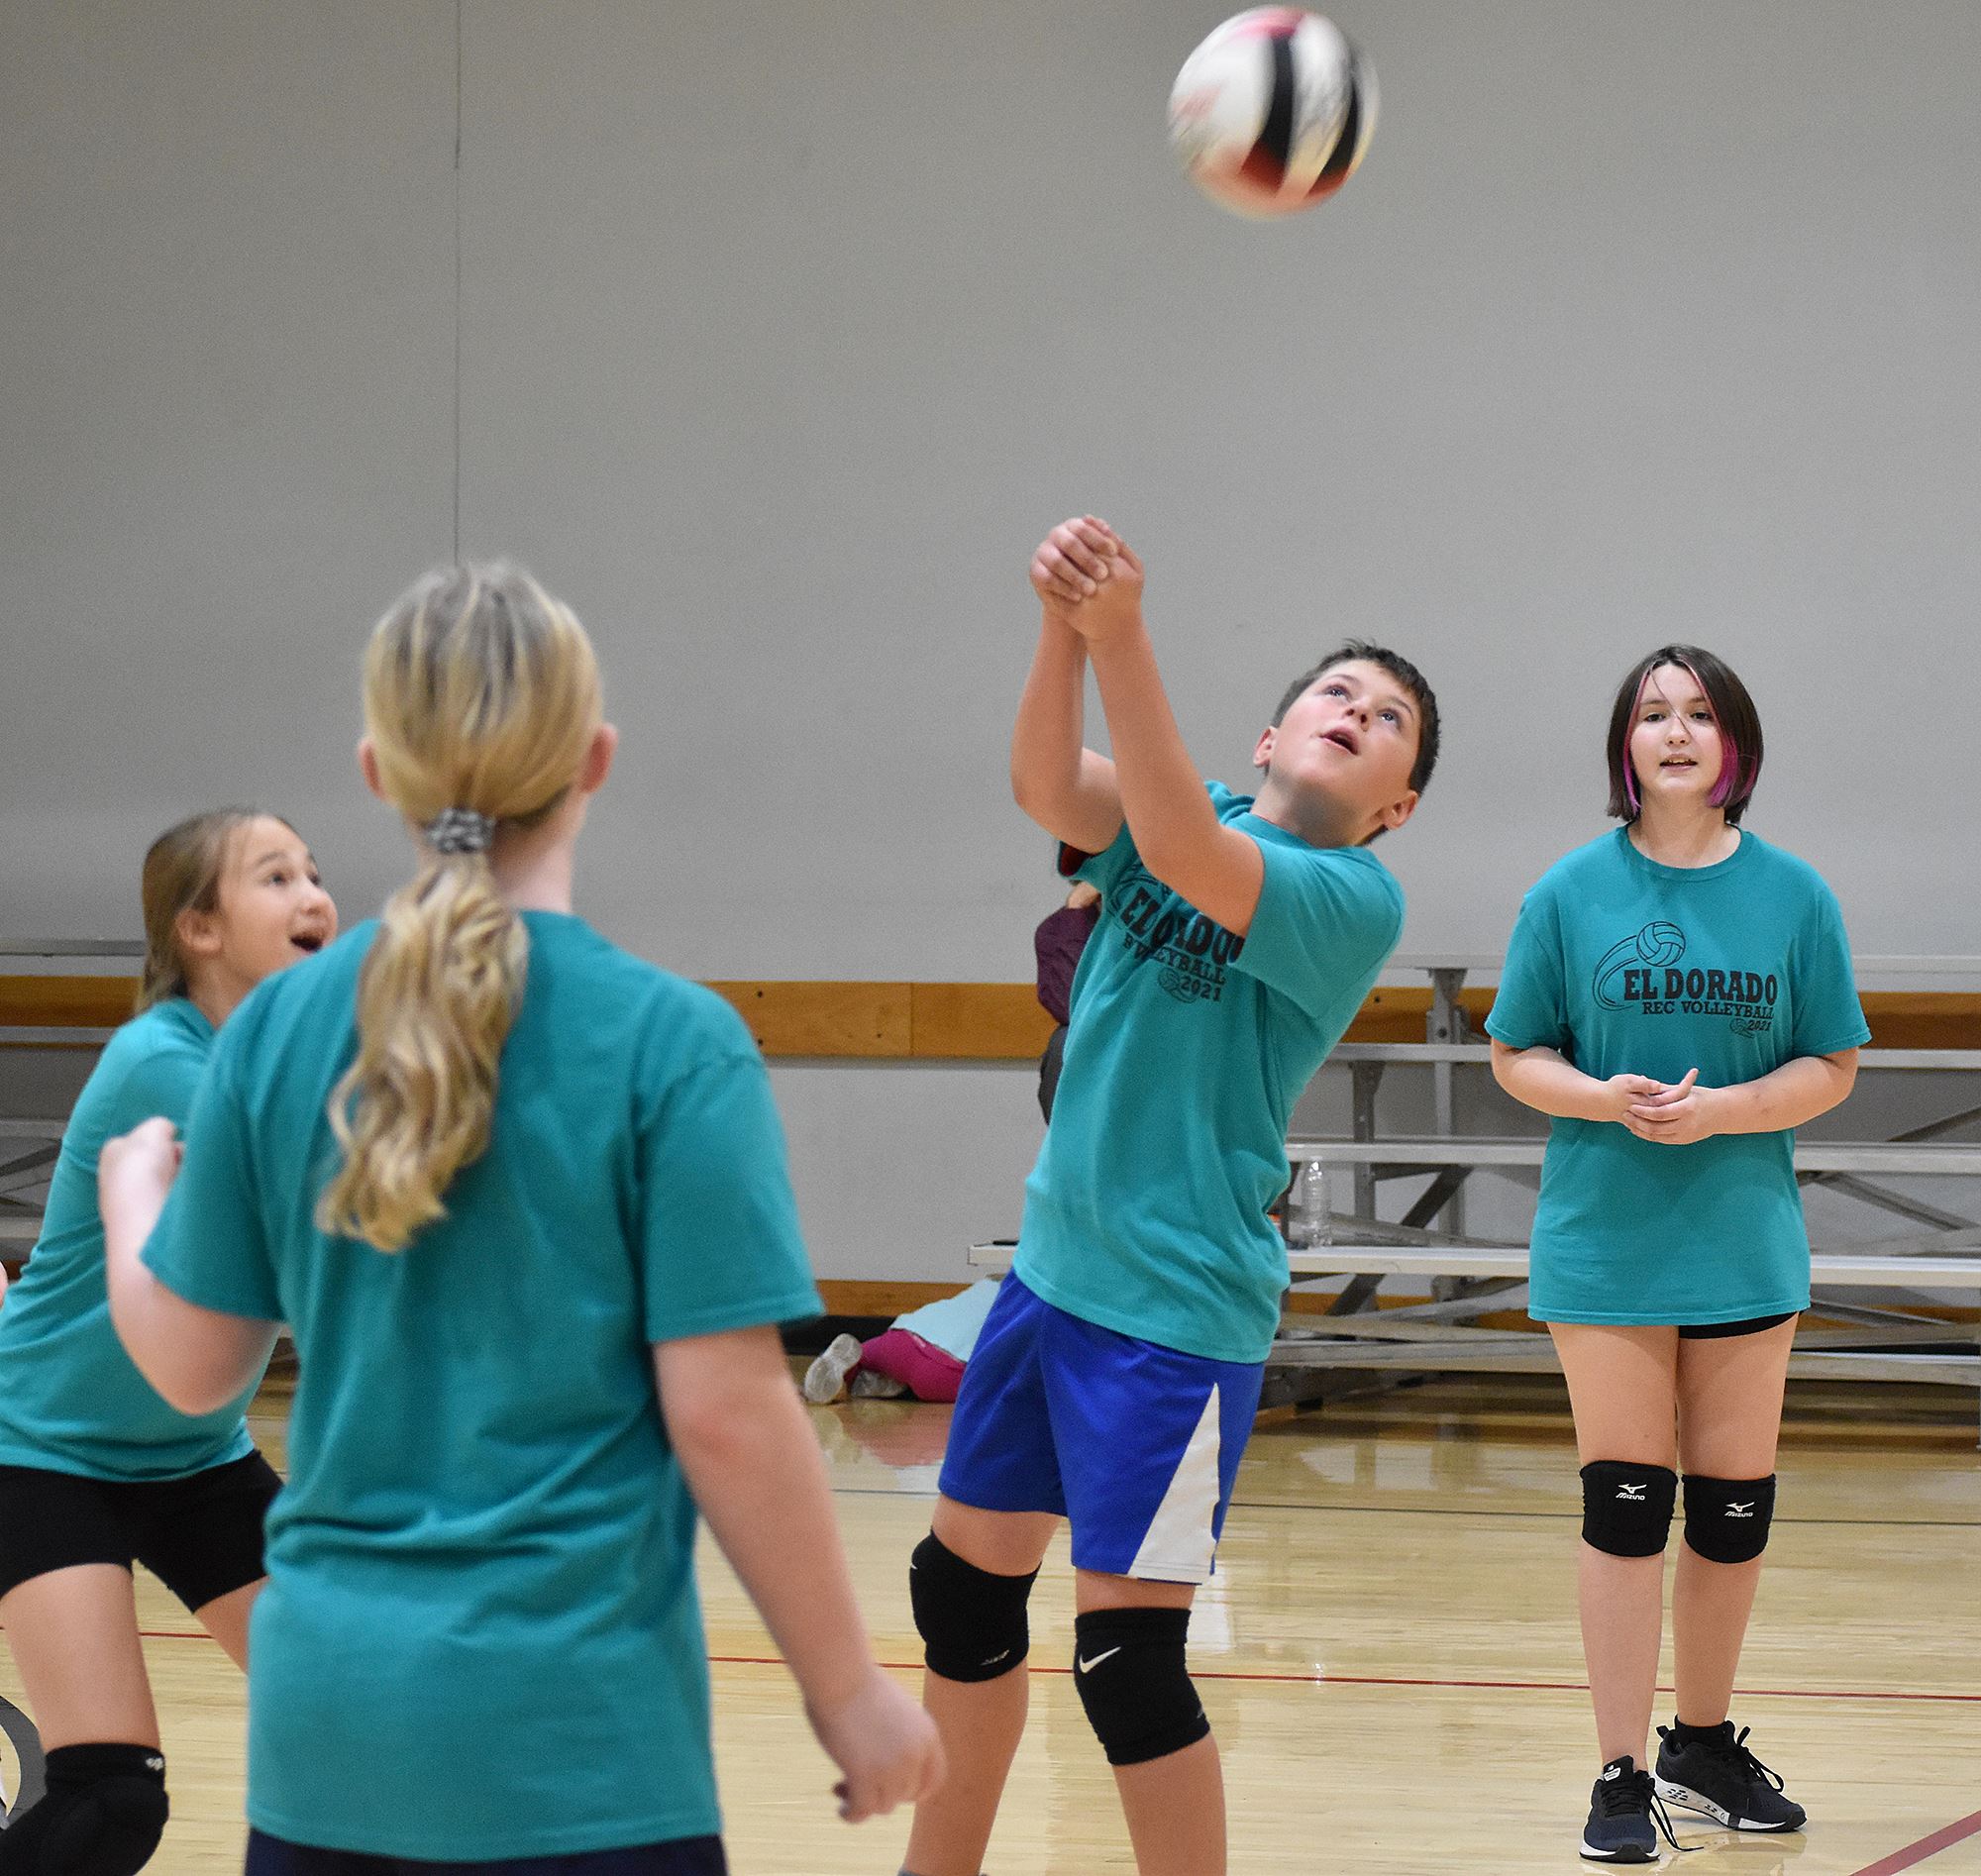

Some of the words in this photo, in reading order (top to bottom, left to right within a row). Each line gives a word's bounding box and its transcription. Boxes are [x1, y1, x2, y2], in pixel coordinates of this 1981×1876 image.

[1120, 886, 1161, 937] EL
[1180, 974, 1223, 1002] 2021
[1623, 969, 1658, 1001] EL
[1665, 968, 1778, 1006] DORADO
[1642, 1000, 1675, 1015] REC
[1681, 1000, 1775, 1020] VOLLEYBALL
[1746, 1019, 1773, 1032] 2021
